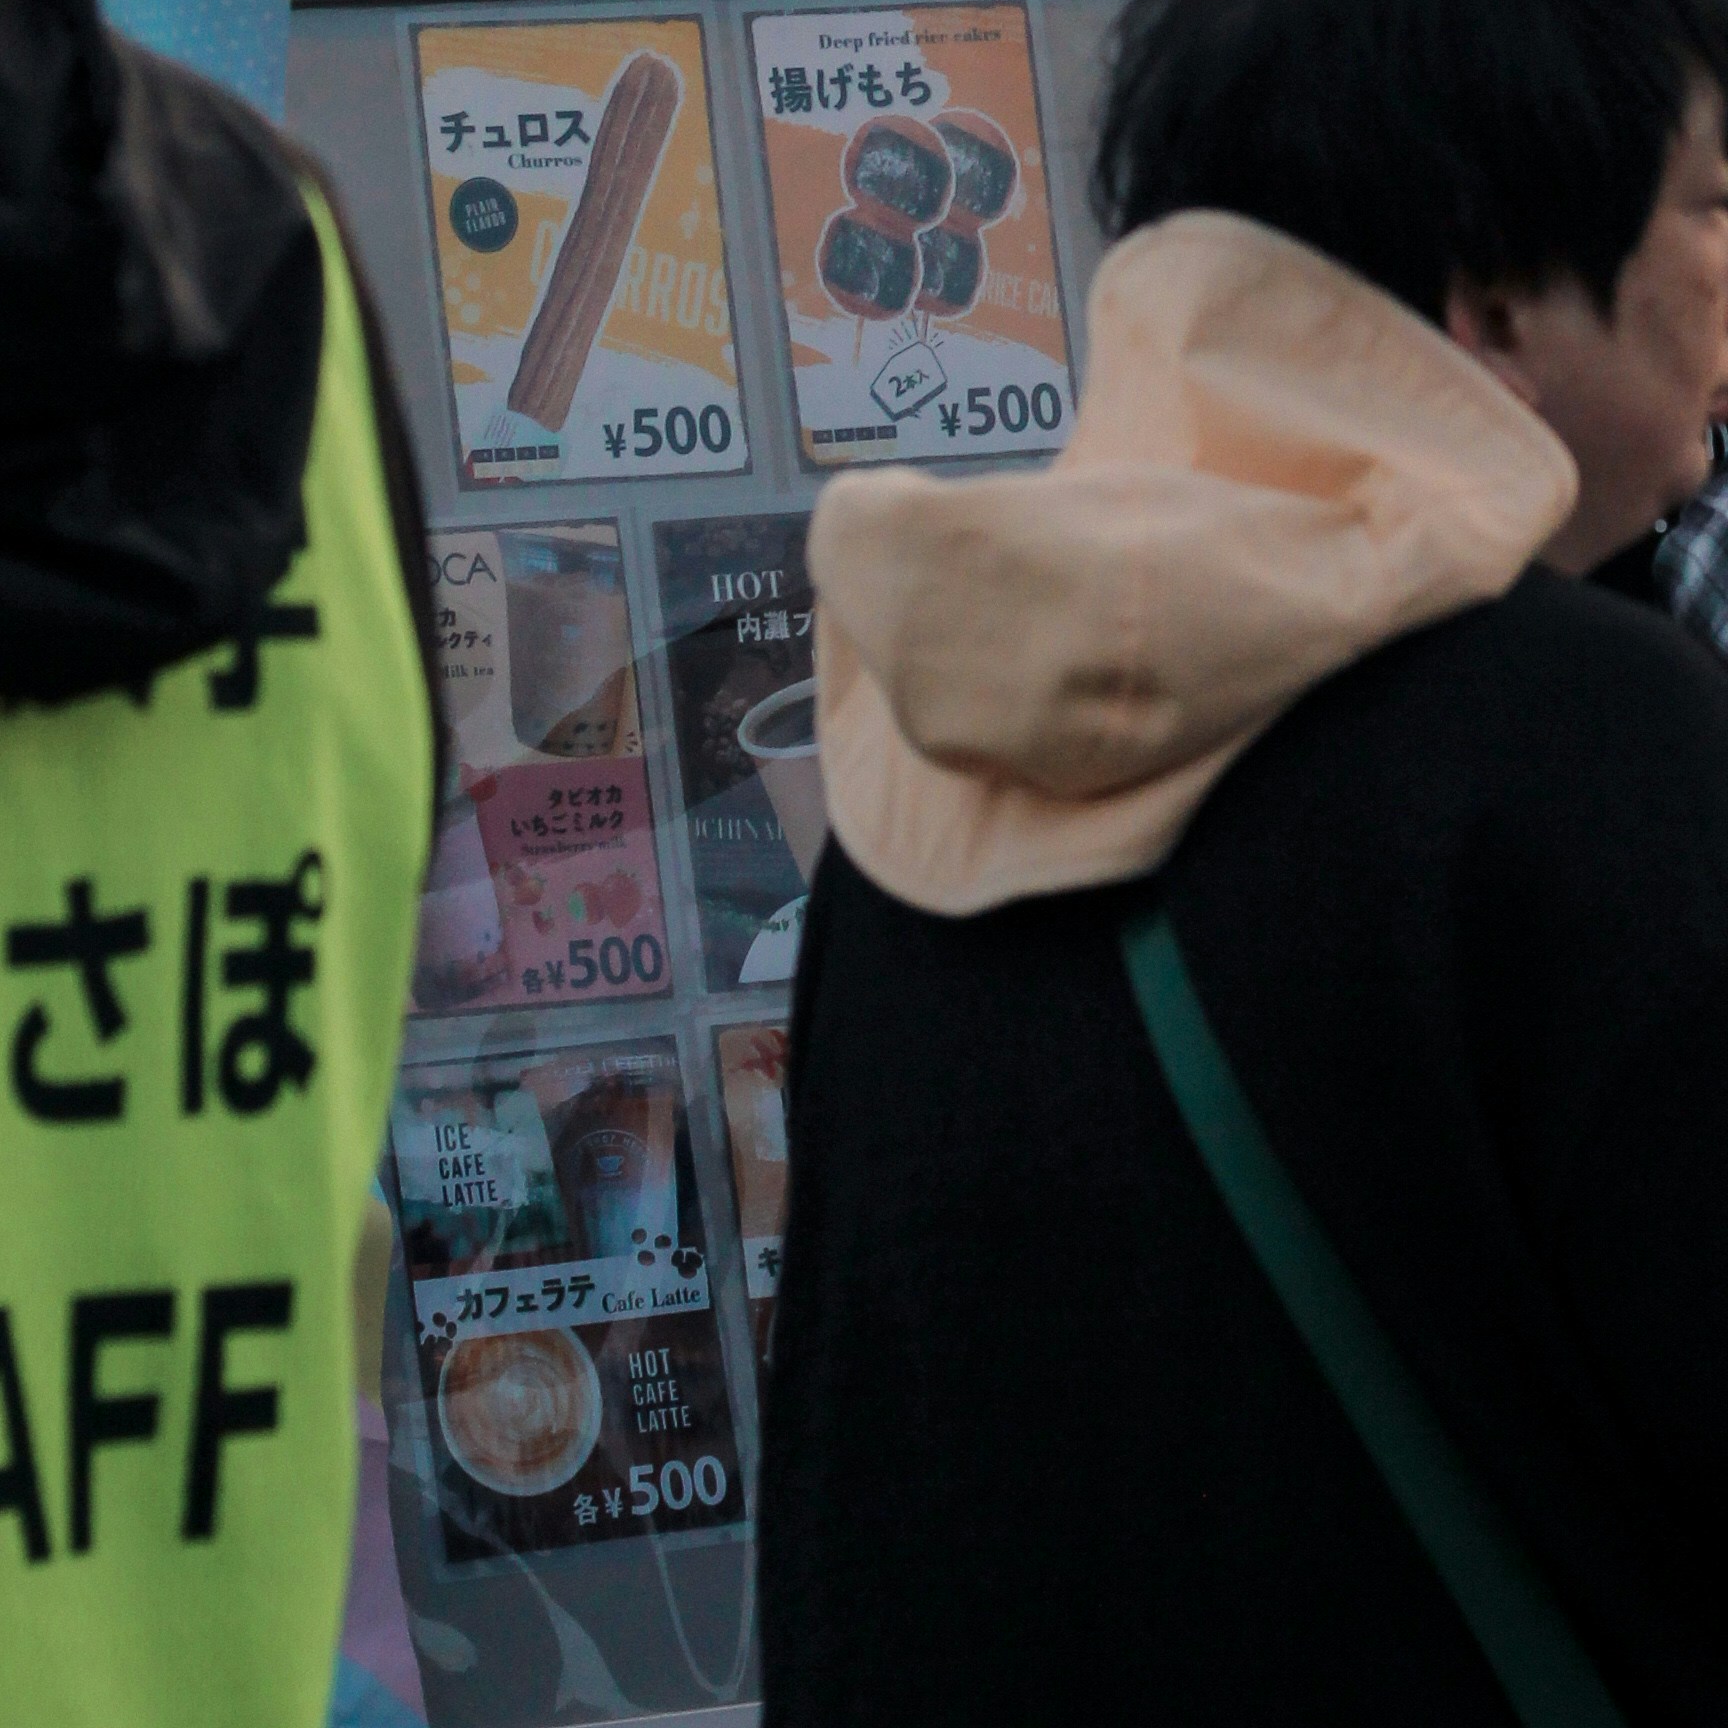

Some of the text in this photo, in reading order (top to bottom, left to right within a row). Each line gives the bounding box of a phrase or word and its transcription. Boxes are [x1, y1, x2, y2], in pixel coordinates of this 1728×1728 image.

[819, 34, 864, 52] Deep
[868, 30, 910, 46] fried
[769, 60, 934, 115] 揚げもち
[440, 108, 592, 153] チュロス
[507, 152, 583, 170] Churros
[939, 382, 1063, 437] ¥500
[603, 405, 732, 459] ¥500
[711, 570, 784, 602] HOT
[511, 810, 624, 837] いちごミルク
[521, 934, 662, 993] 各¥500
[434, 1123, 471, 1154] ICE
[438, 1154, 486, 1179] CAFE
[442, 1181, 499, 1208] LATTE
[456, 1275, 701, 1322] カフェラテ Cafe Latte
[628, 1348, 670, 1379] HOT
[633, 1380, 679, 1405] CAFE
[637, 1405, 692, 1433] LATTE
[573, 1455, 727, 1526] 各¥500
